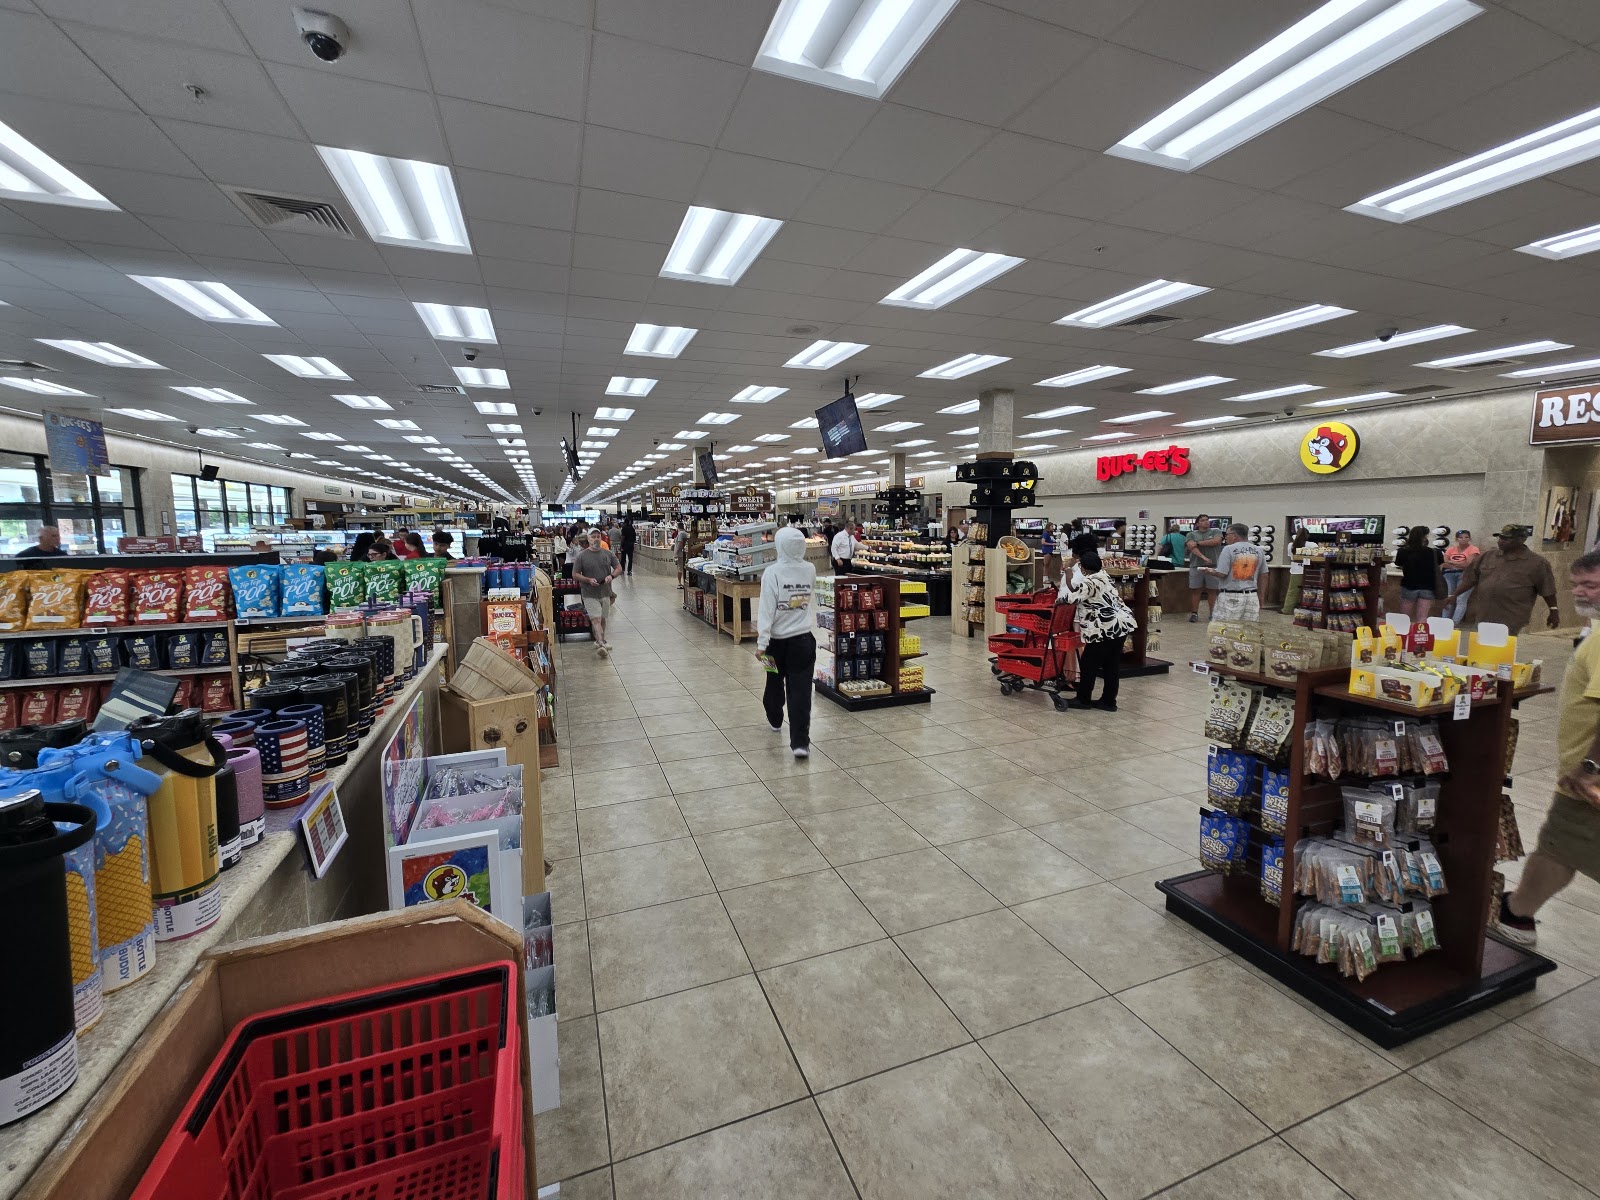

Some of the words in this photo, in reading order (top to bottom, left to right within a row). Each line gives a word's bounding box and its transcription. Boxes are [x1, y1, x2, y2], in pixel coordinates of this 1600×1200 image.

[1096, 445, 1191, 482] BUC-EE'S
[1328, 520, 1362, 532] FREE
[187, 583, 223, 603] POP
[237, 583, 267, 602] POP
[284, 579, 317, 598] POP
[331, 580, 359, 600] POP
[367, 578, 395, 594] POP
[409, 575, 436, 592] POP
[31, 586, 72, 608] POP
[138, 587, 175, 605] POP
[1272, 651, 1301, 661] PECANS
[163, 904, 175, 933] BOTTLE
[118, 947, 130, 980] BUDDY
[136, 938, 147, 972] BOTTLE
